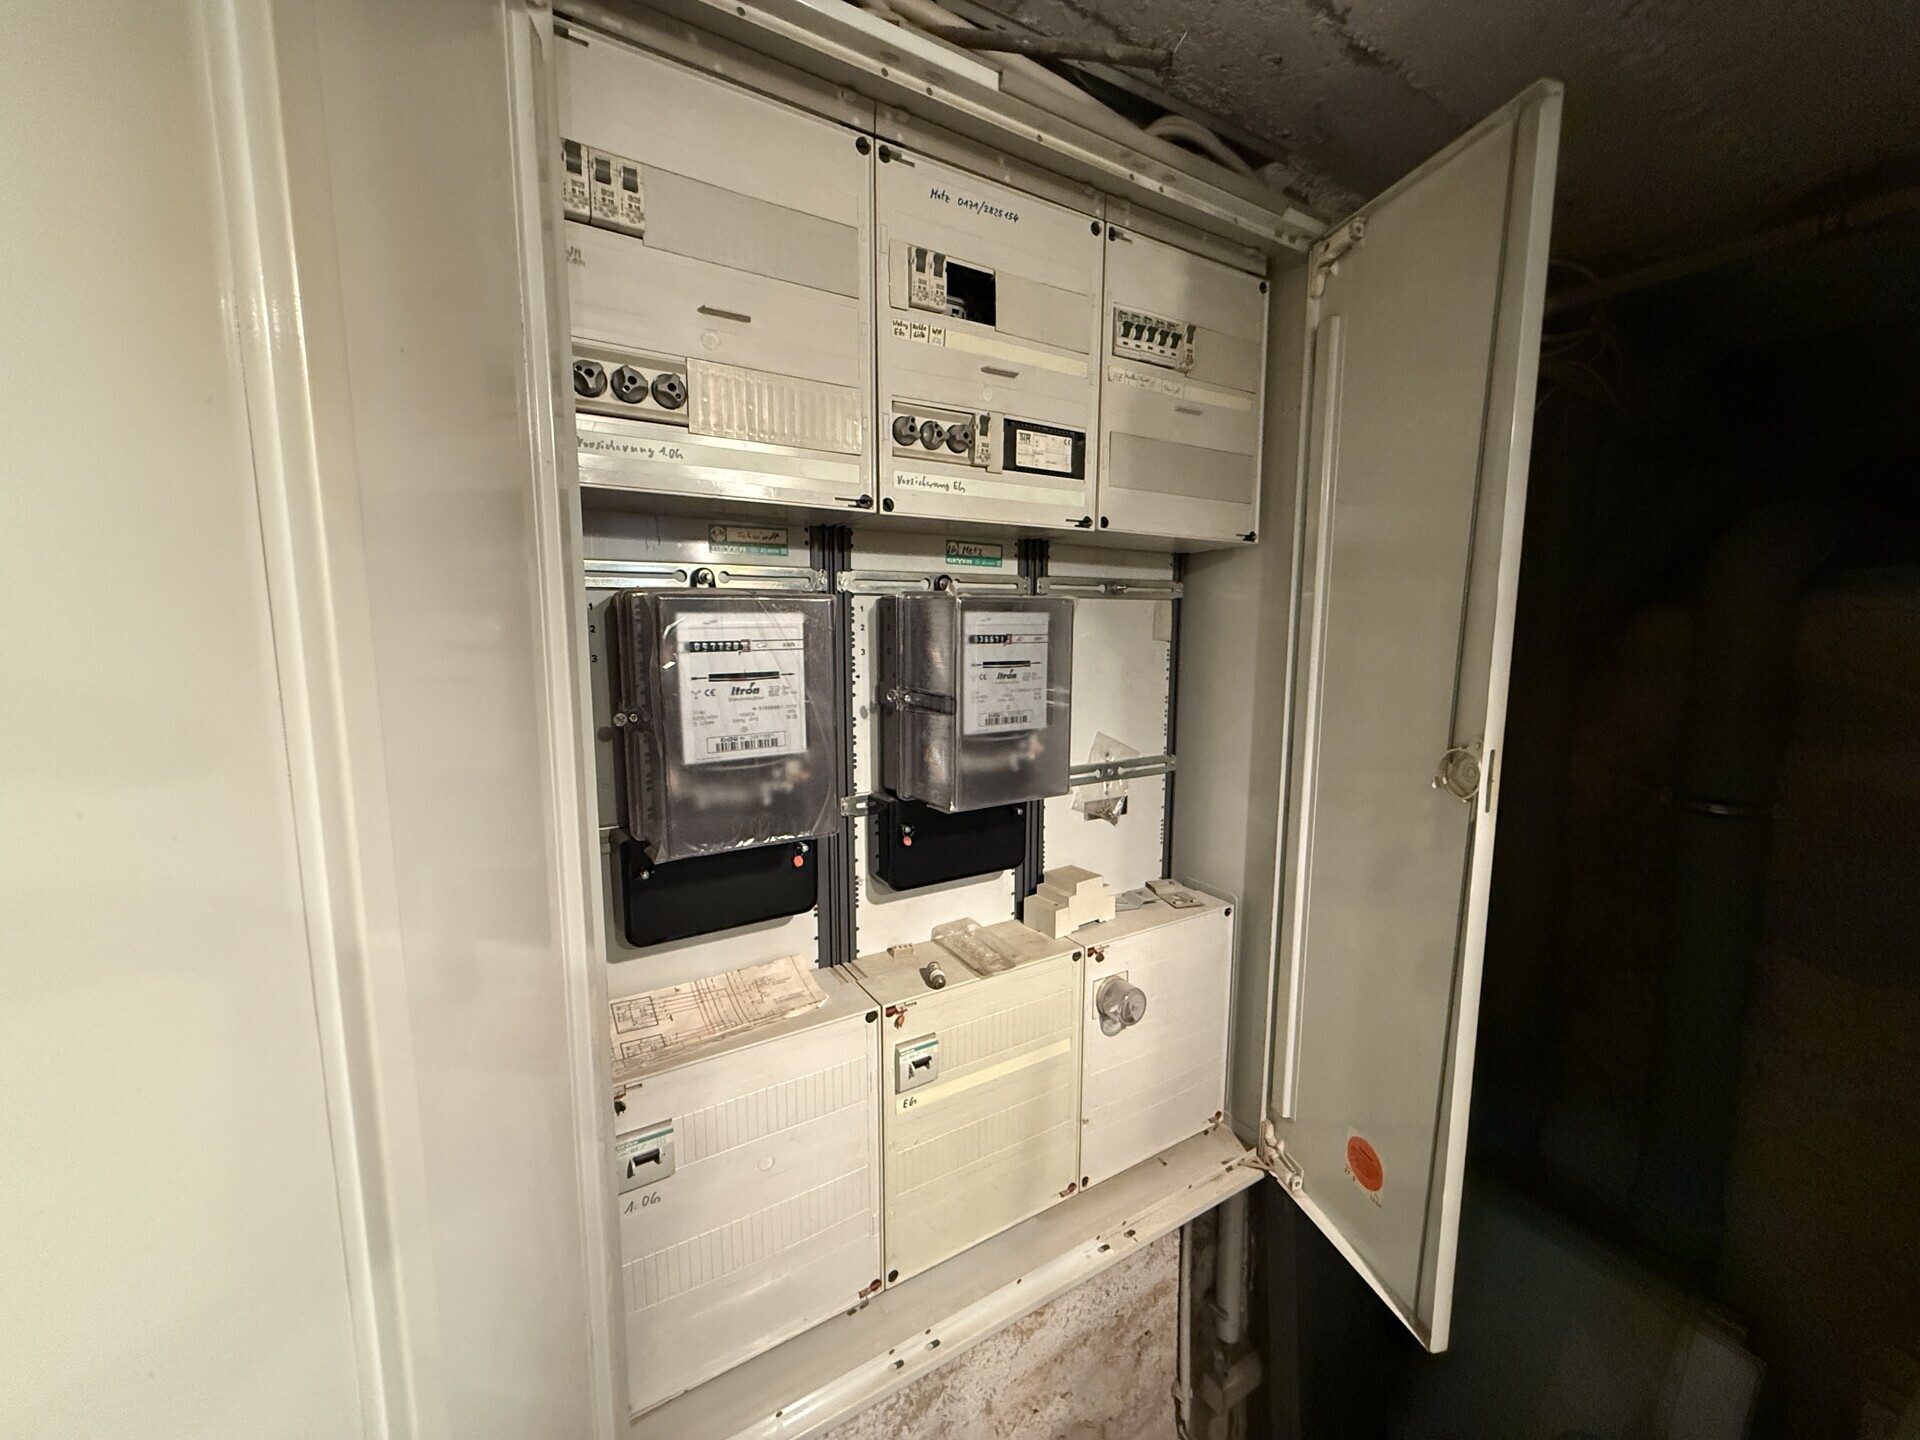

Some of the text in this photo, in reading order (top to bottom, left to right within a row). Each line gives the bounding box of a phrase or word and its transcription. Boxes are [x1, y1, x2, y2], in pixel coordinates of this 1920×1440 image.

[588, 602, 593, 611] 1
[589, 625, 596, 633] 2
[860, 648, 866, 656] 3
[591, 654, 598, 663] 3
